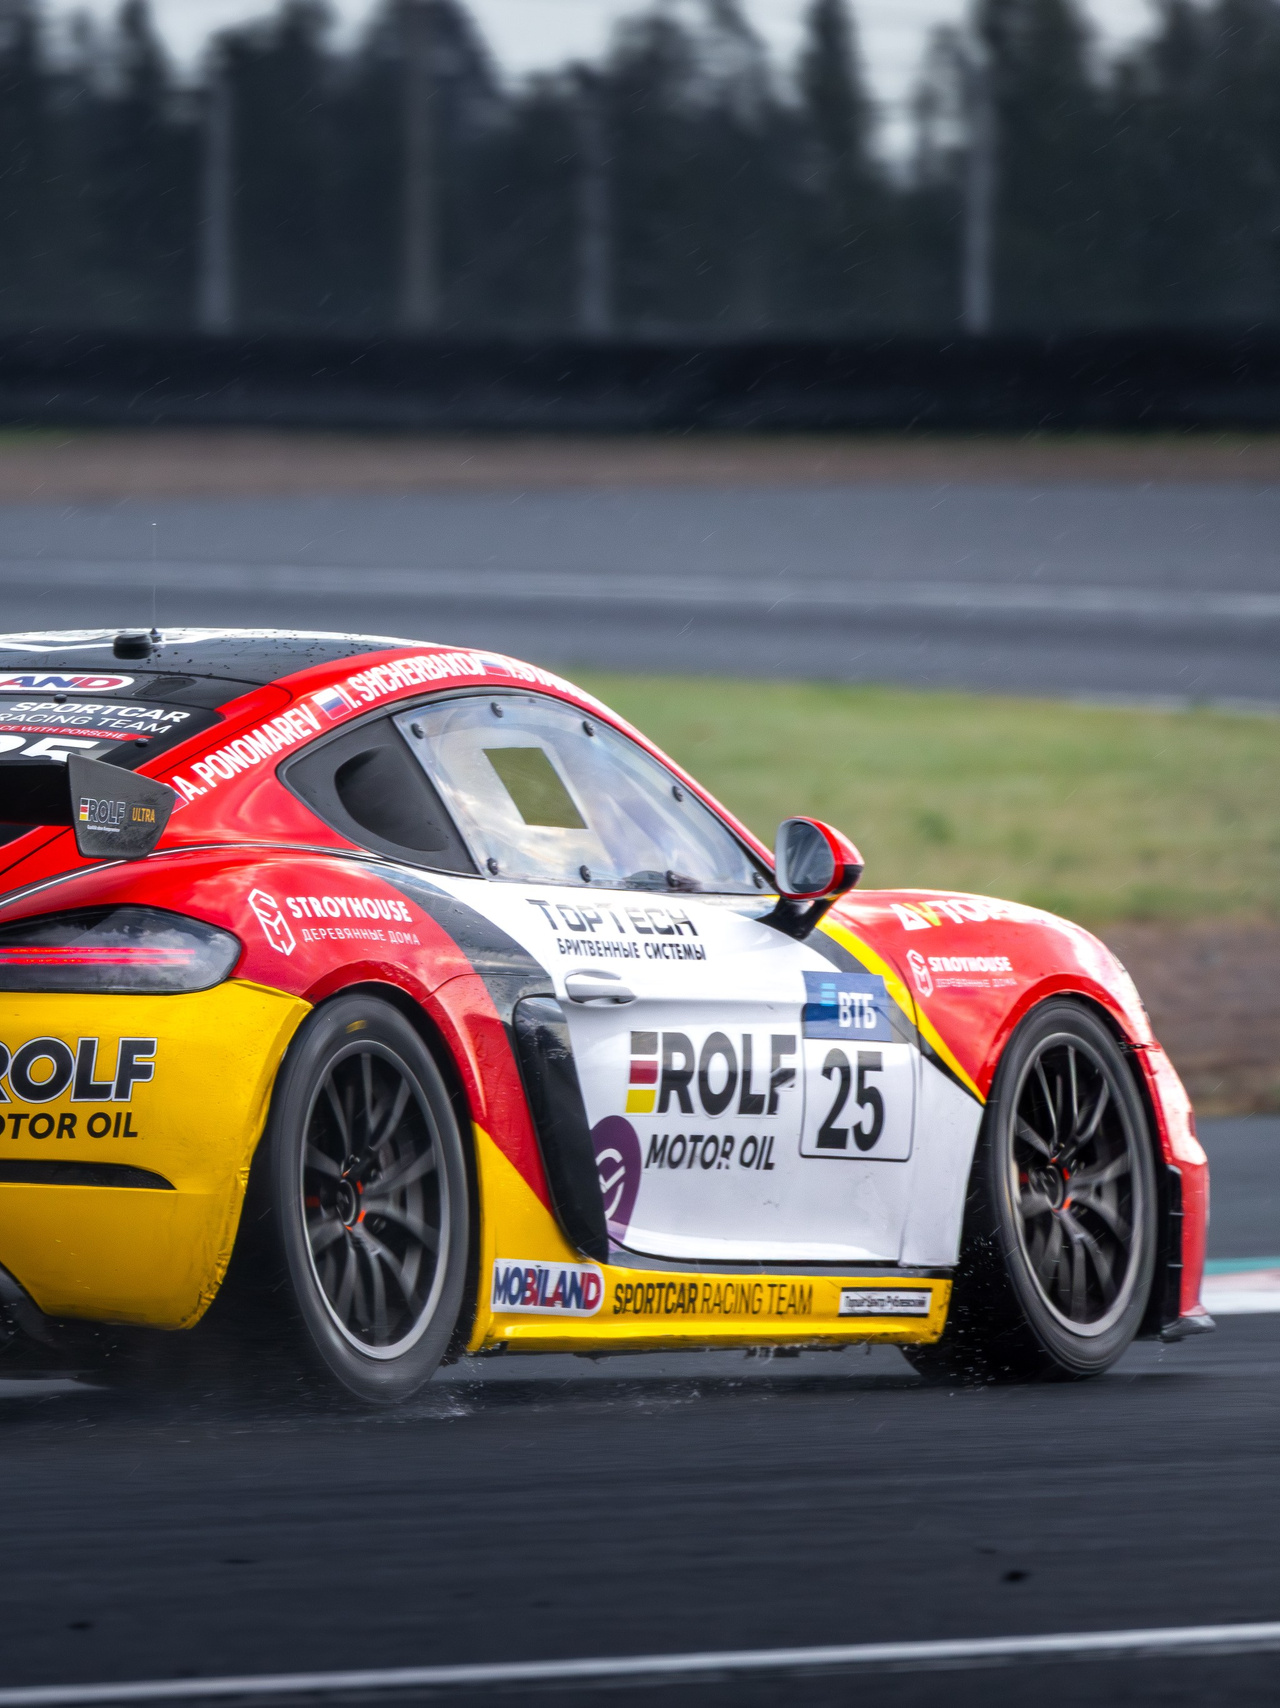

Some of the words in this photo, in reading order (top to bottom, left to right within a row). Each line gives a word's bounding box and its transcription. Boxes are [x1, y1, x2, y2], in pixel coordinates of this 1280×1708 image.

[333, 684, 361, 709] I.
[9, 701, 191, 723] SPORTCAR
[96, 716, 173, 734] TEAM
[21, 725, 59, 733] WITH
[61, 727, 128, 740] PORSCHE
[171, 775, 208, 801] A.
[190, 703, 322, 788] PONOMAREV
[88, 798, 126, 824] ROLF
[131, 806, 156, 824] ULTRA
[285, 896, 413, 923] STROYHOUSE
[301, 928, 387, 942] ДЕРЕВЯННЫЕ
[389, 930, 421, 946] ДОМА
[556, 937, 641, 959] БРИТВЕННЫЕ
[644, 942, 707, 961] СИСТЕМЫ
[838, 991, 877, 1030] ВТБ
[657, 1030, 797, 1116] ROLF
[816, 1047, 886, 1152] 25
[86, 1111, 139, 1139] OIL
[644, 1133, 735, 1170] MOTOR
[739, 1135, 776, 1171] OIL
[493, 1266, 601, 1310] MOBILAND
[613, 1282, 698, 1315] SPORTCAR
[700, 1282, 763, 1314] RACING
[767, 1283, 814, 1315] TEAM
